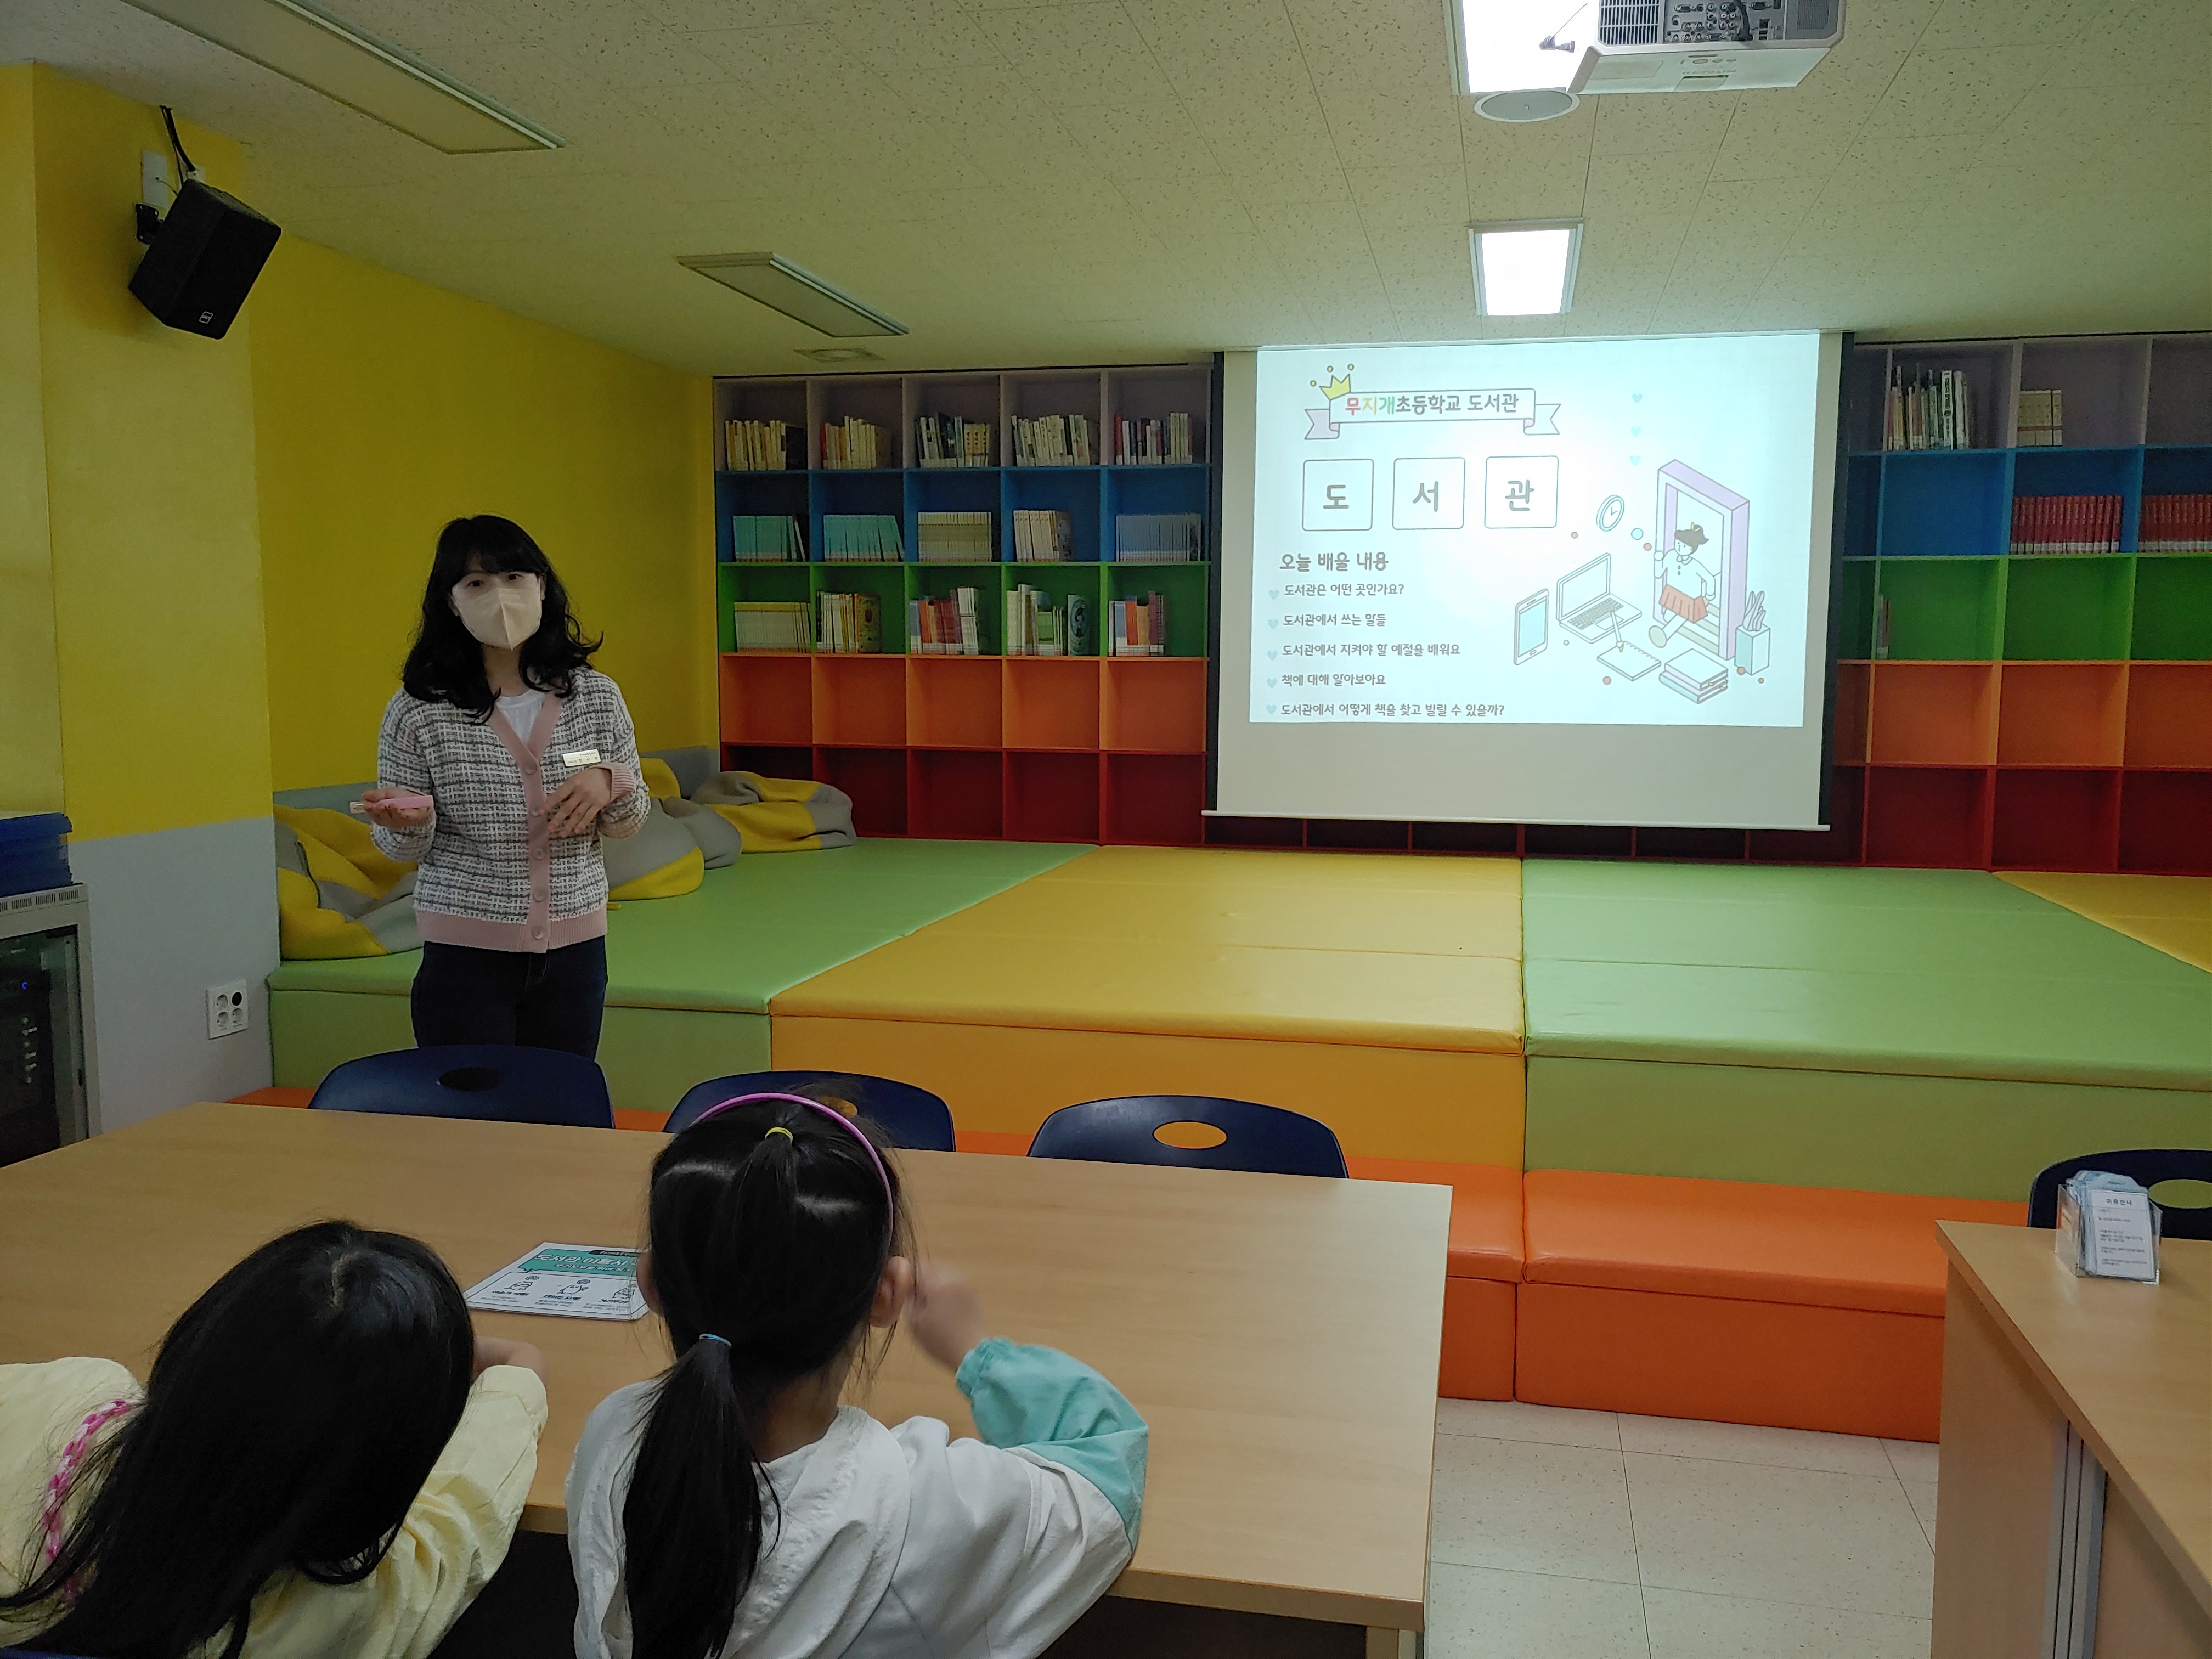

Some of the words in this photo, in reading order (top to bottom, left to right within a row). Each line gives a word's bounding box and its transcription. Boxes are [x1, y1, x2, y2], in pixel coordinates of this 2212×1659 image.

[1345, 395, 1461, 415] 무지개초등학교
[1467, 393, 1519, 413] 도서관
[1323, 484, 1349, 509] 도
[1412, 481, 1438, 512] 서
[1505, 479, 1534, 511] 관
[1279, 553, 1311, 572] 오늘
[1317, 552, 1350, 571] 배울
[1356, 551, 1389, 571] 내용
[1284, 584, 1327, 596] 도서관은
[1330, 583, 1352, 596] 어떤
[1355, 583, 1404, 596] 곳인가요?
[1282, 613, 1337, 626] 도서관에서
[1340, 613, 1362, 626] 쓰는
[1365, 613, 1386, 627] 말들
[1282, 644, 1336, 656] 도서관에서
[1340, 644, 1373, 656] 지켜야
[1376, 644, 1388, 656] 할
[1391, 644, 1424, 657] 예절을
[1427, 643, 1461, 656] 배워요
[1281, 674, 1304, 687] 책에
[1307, 674, 1329, 686] 대해
[1333, 674, 1386, 686] 알아보아요
[1280, 703, 1335, 716] 도서관에서
[1338, 703, 1372, 716] 어떻게
[1374, 703, 1397, 716] 책을
[1399, 703, 1421, 716] 찾고
[1425, 704, 1447, 716] 빌릴
[1450, 704, 1462, 716] 수
[1465, 704, 1505, 717] 있을까?
[534, 1254, 582, 1262] 도서관
